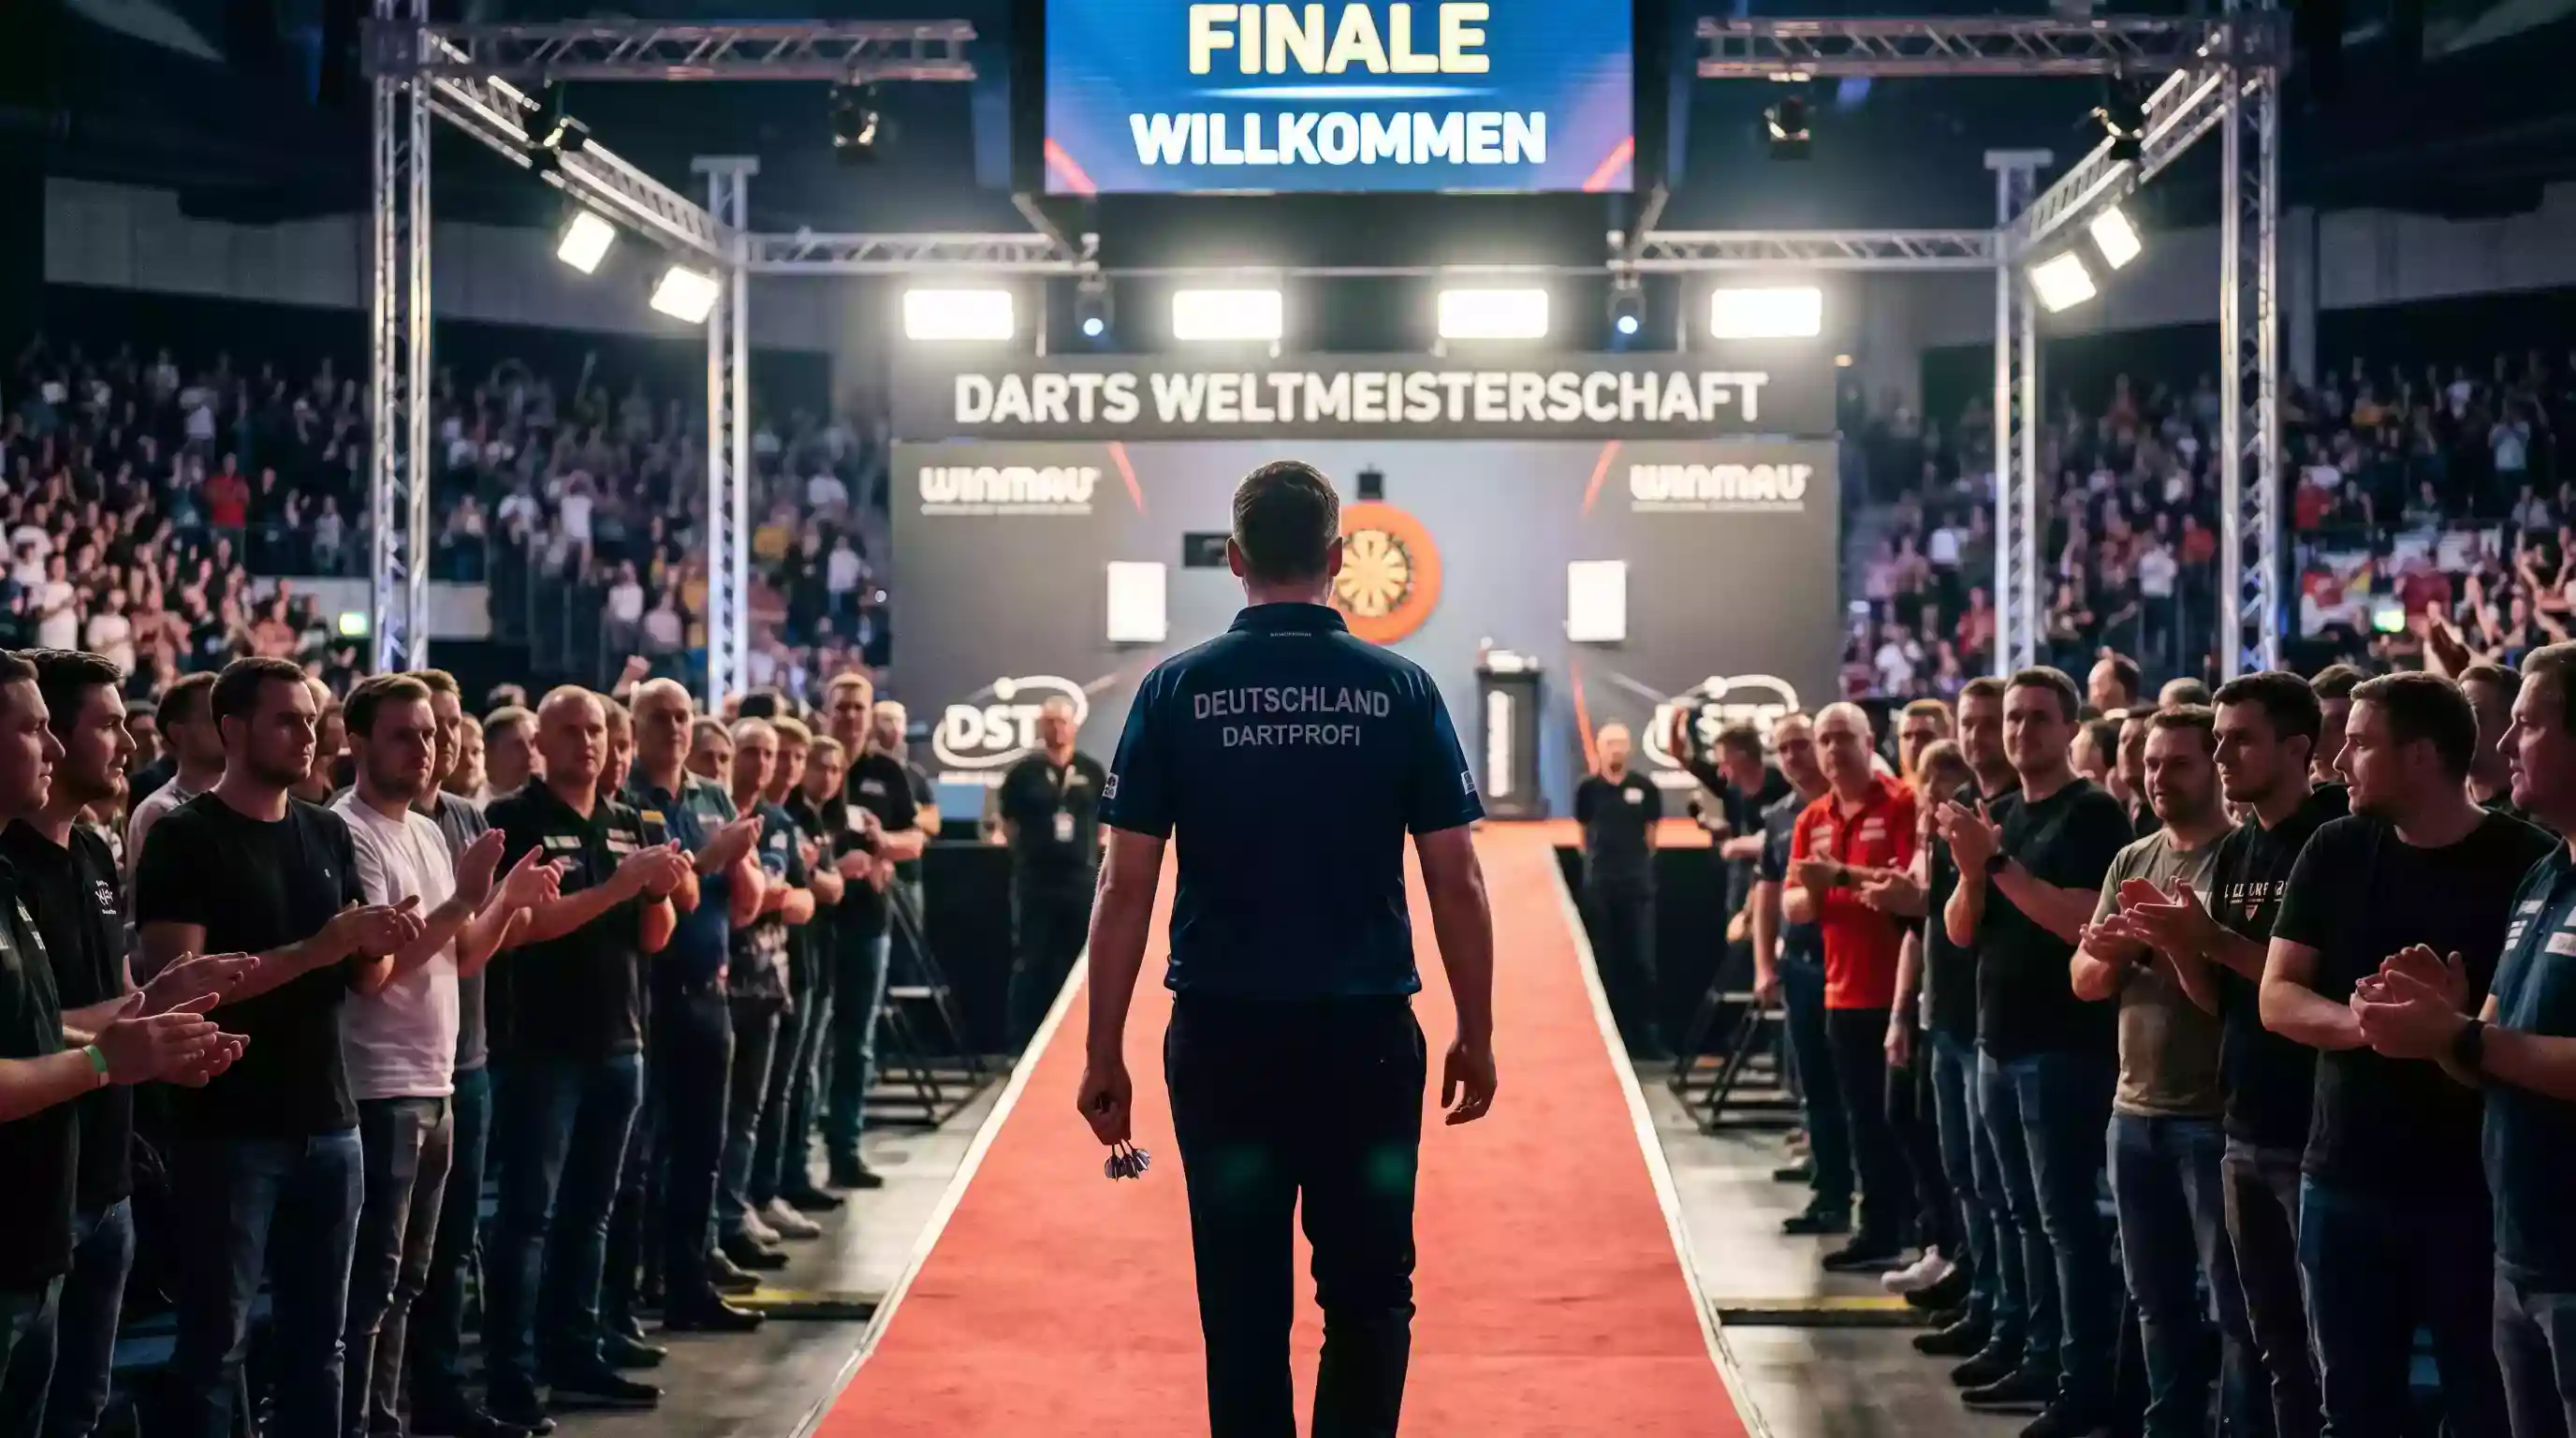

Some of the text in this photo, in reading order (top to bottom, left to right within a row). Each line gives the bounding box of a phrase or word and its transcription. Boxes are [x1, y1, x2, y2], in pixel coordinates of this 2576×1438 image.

[1189, 2, 1490, 74] FINALE
[1129, 111, 1547, 166] WILLKOMMEN
[954, 371, 1770, 424] DARTS WELTMEISTERSCHAFT
[1193, 686, 1390, 720] DEUTSCHLAND
[1222, 724, 1361, 748] DARTPROFI
